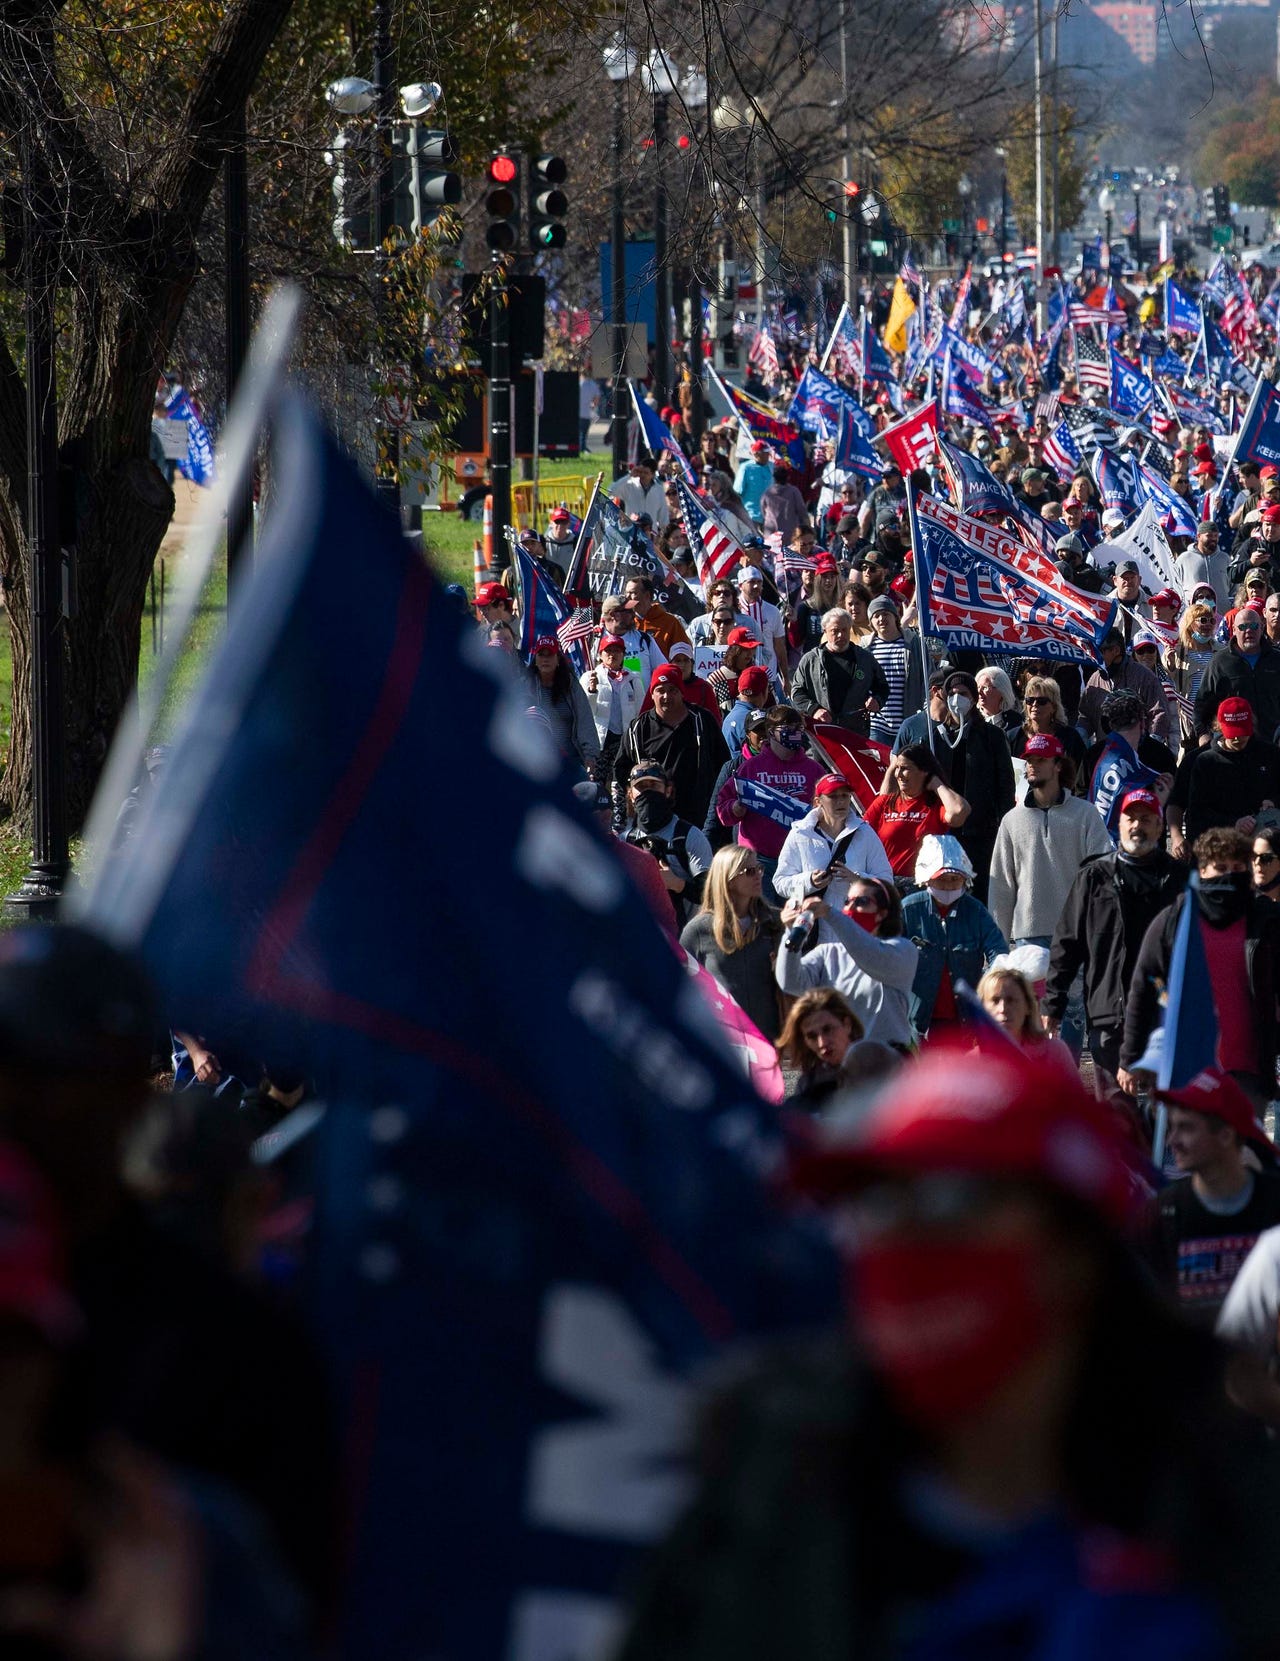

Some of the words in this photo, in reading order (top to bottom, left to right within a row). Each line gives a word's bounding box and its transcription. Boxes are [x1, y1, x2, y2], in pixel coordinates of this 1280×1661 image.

[850, 453, 873, 466] KEEP
[969, 481, 1000, 496] MAKE
[918, 498, 1028, 568] RE-ELECT
[591, 541, 606, 561] A
[614, 543, 657, 574] Hero
[1132, 535, 1170, 583] LIBERTY
[538, 638, 556, 647] USA
[756, 771, 807, 788] Trump
